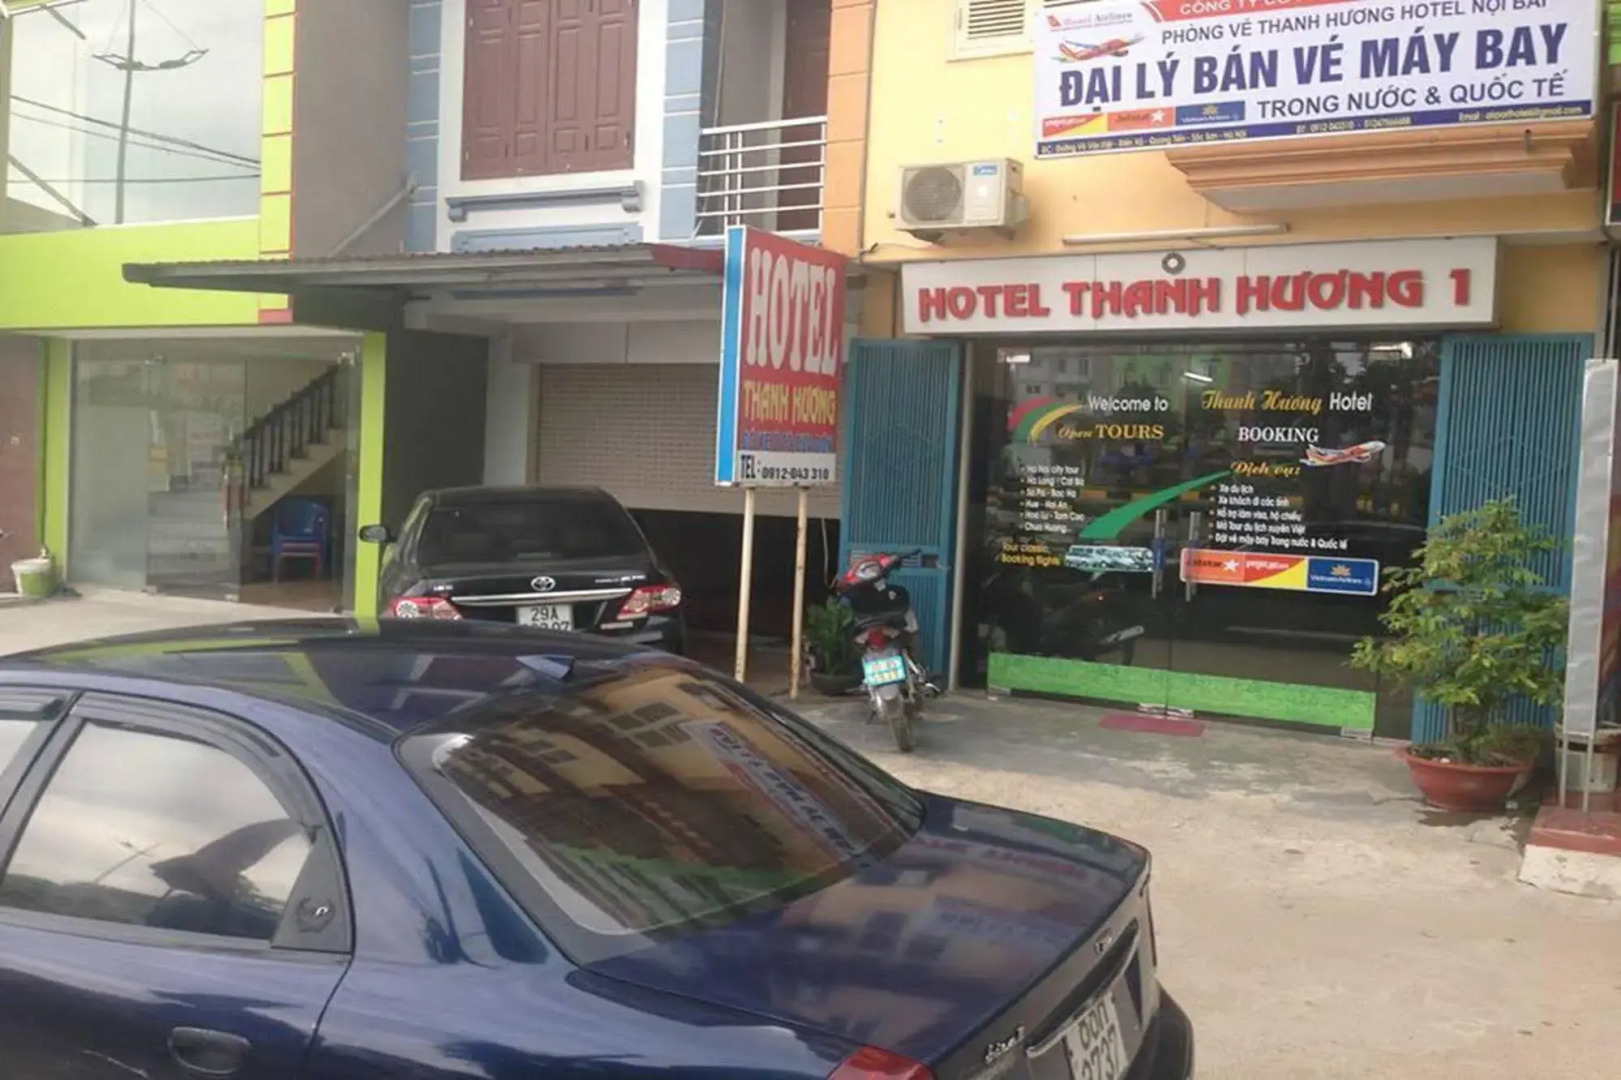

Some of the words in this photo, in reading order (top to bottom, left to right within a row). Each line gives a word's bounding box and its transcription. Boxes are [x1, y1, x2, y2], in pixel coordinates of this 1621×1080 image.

[1161, 24, 1224, 45] PHÒNG
[1258, 14, 1321, 35] THANH
[1326, 6, 1394, 28] HƯƠNG
[1401, 1, 1465, 20] HOTEL
[1059, 64, 1122, 112] ĐẠI
[1136, 51, 1180, 100] LÝ
[1193, 45, 1279, 94] BÁN
[1293, 35, 1343, 86] VÉ
[1359, 26, 1460, 79] MÁY
[1475, 22, 1568, 70] BAY
[1257, 95, 1339, 119] TRONG
[1346, 85, 1417, 112] NƯỚC
[1424, 86, 1442, 106] &
[1450, 72, 1524, 104] QUỐC
[1532, 69, 1568, 98] TẾ
[917, 282, 1051, 323] HOTEL
[1063, 275, 1221, 319] THANH
[1236, 269, 1424, 318] HƯƠNG
[1449, 267, 1472, 307] 1
[746, 247, 838, 377] HOTEL
[742, 379, 790, 423] THANH
[791, 384, 836, 426] HƯƠNG
[1087, 394, 1151, 412] Welcome
[1154, 395, 1169, 412] to
[1202, 389, 1256, 411] Thanh
[1329, 391, 1373, 412] Hotel
[1058, 426, 1093, 440] Open
[1094, 423, 1165, 440] TOURS
[1238, 426, 1320, 443] BOOKING
[1230, 460, 1270, 477] Dịch
[531, 606, 560, 622] 29A
